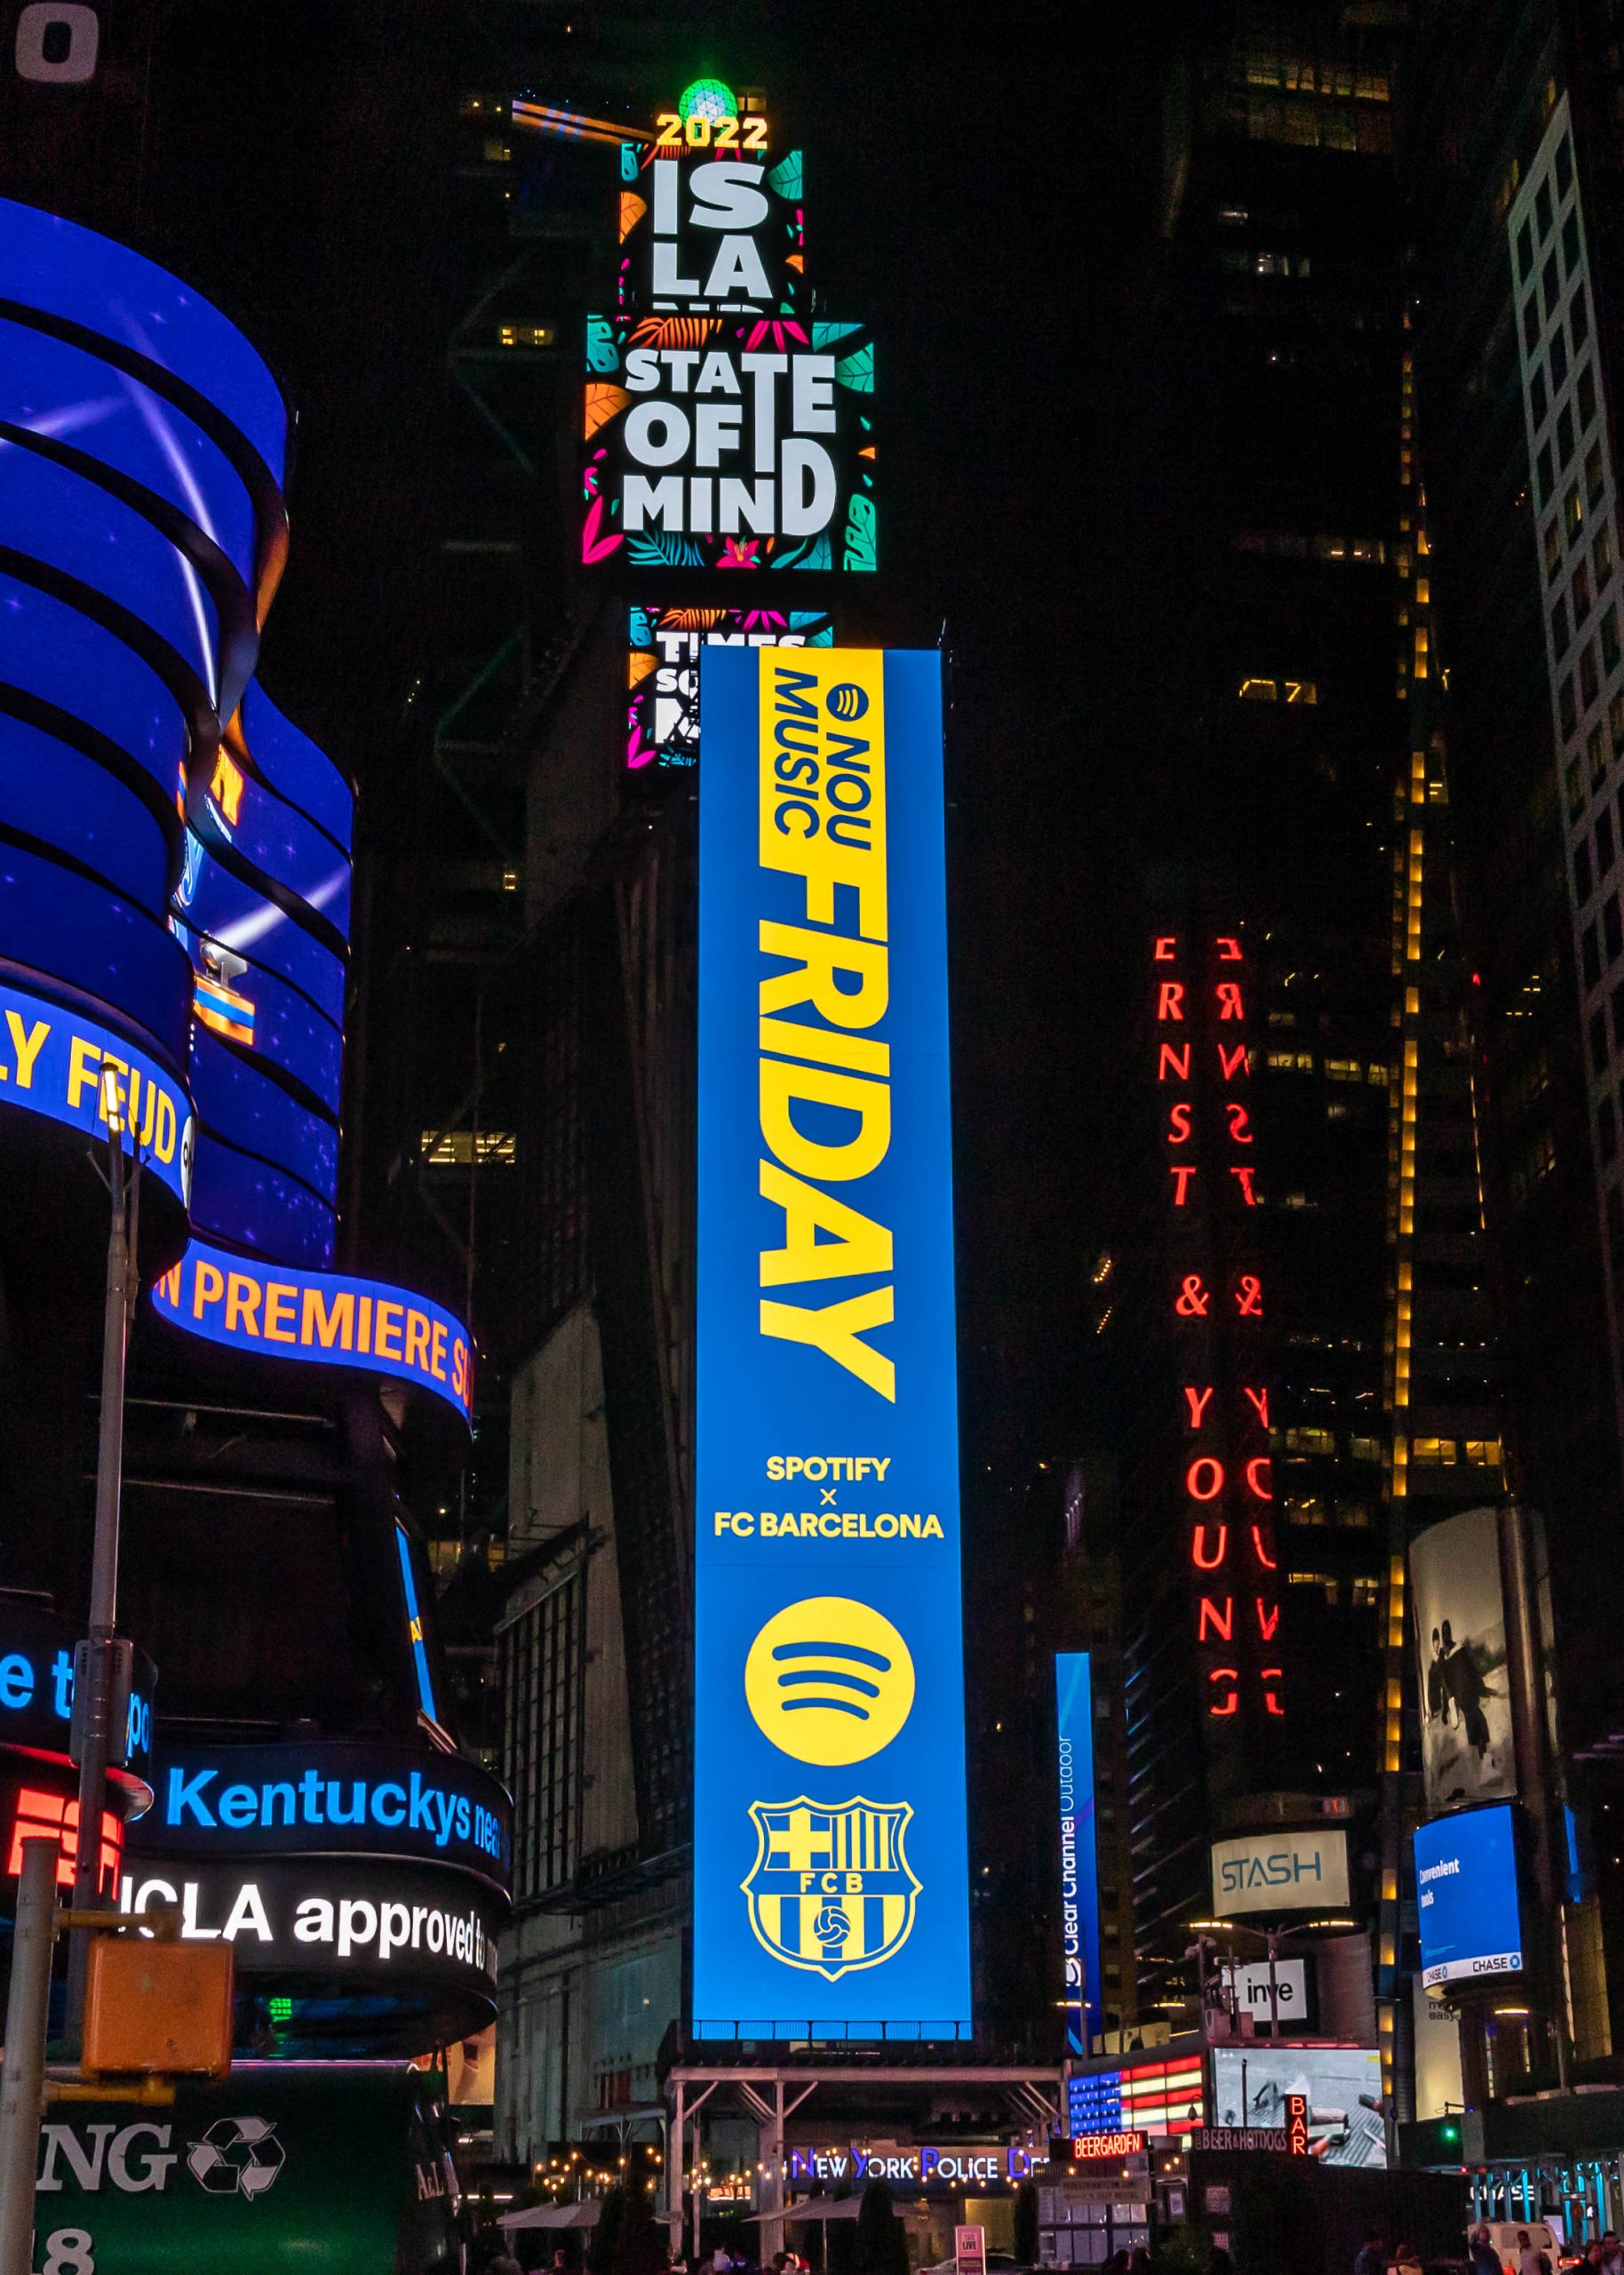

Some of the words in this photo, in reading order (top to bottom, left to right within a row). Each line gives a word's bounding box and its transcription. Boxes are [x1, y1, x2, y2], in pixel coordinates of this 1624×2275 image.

[657, 114, 768, 149] 2022
[654, 158, 768, 235] IS
[653, 235, 774, 299] LA
[624, 401, 743, 467] OF
[625, 348, 835, 472] STATE
[623, 439, 837, 535] MIND
[774, 667, 820, 839] MUSIC
[825, 732, 872, 850] NOU
[759, 853, 896, 1404] FRIDAY
[193, 1259, 449, 1382] PREMIERE
[1175, 1274, 1208, 1316] &
[767, 1456, 891, 1481] SPOTIFY
[714, 1512, 754, 1537] FC
[760, 1513, 944, 1538] BARCELONA
[167, 1768, 470, 1846] Kentuckys
[1058, 1736, 1074, 1812] Outdoor
[1062, 1816, 1077, 1898] Channel
[1222, 1851, 1322, 1892] STASH
[293, 1898, 474, 1960] approved
[1064, 1901, 1079, 1955] Clear
[1472, 1958, 1508, 1972] CHASE
[1291, 2096, 1307, 2155] BAR
